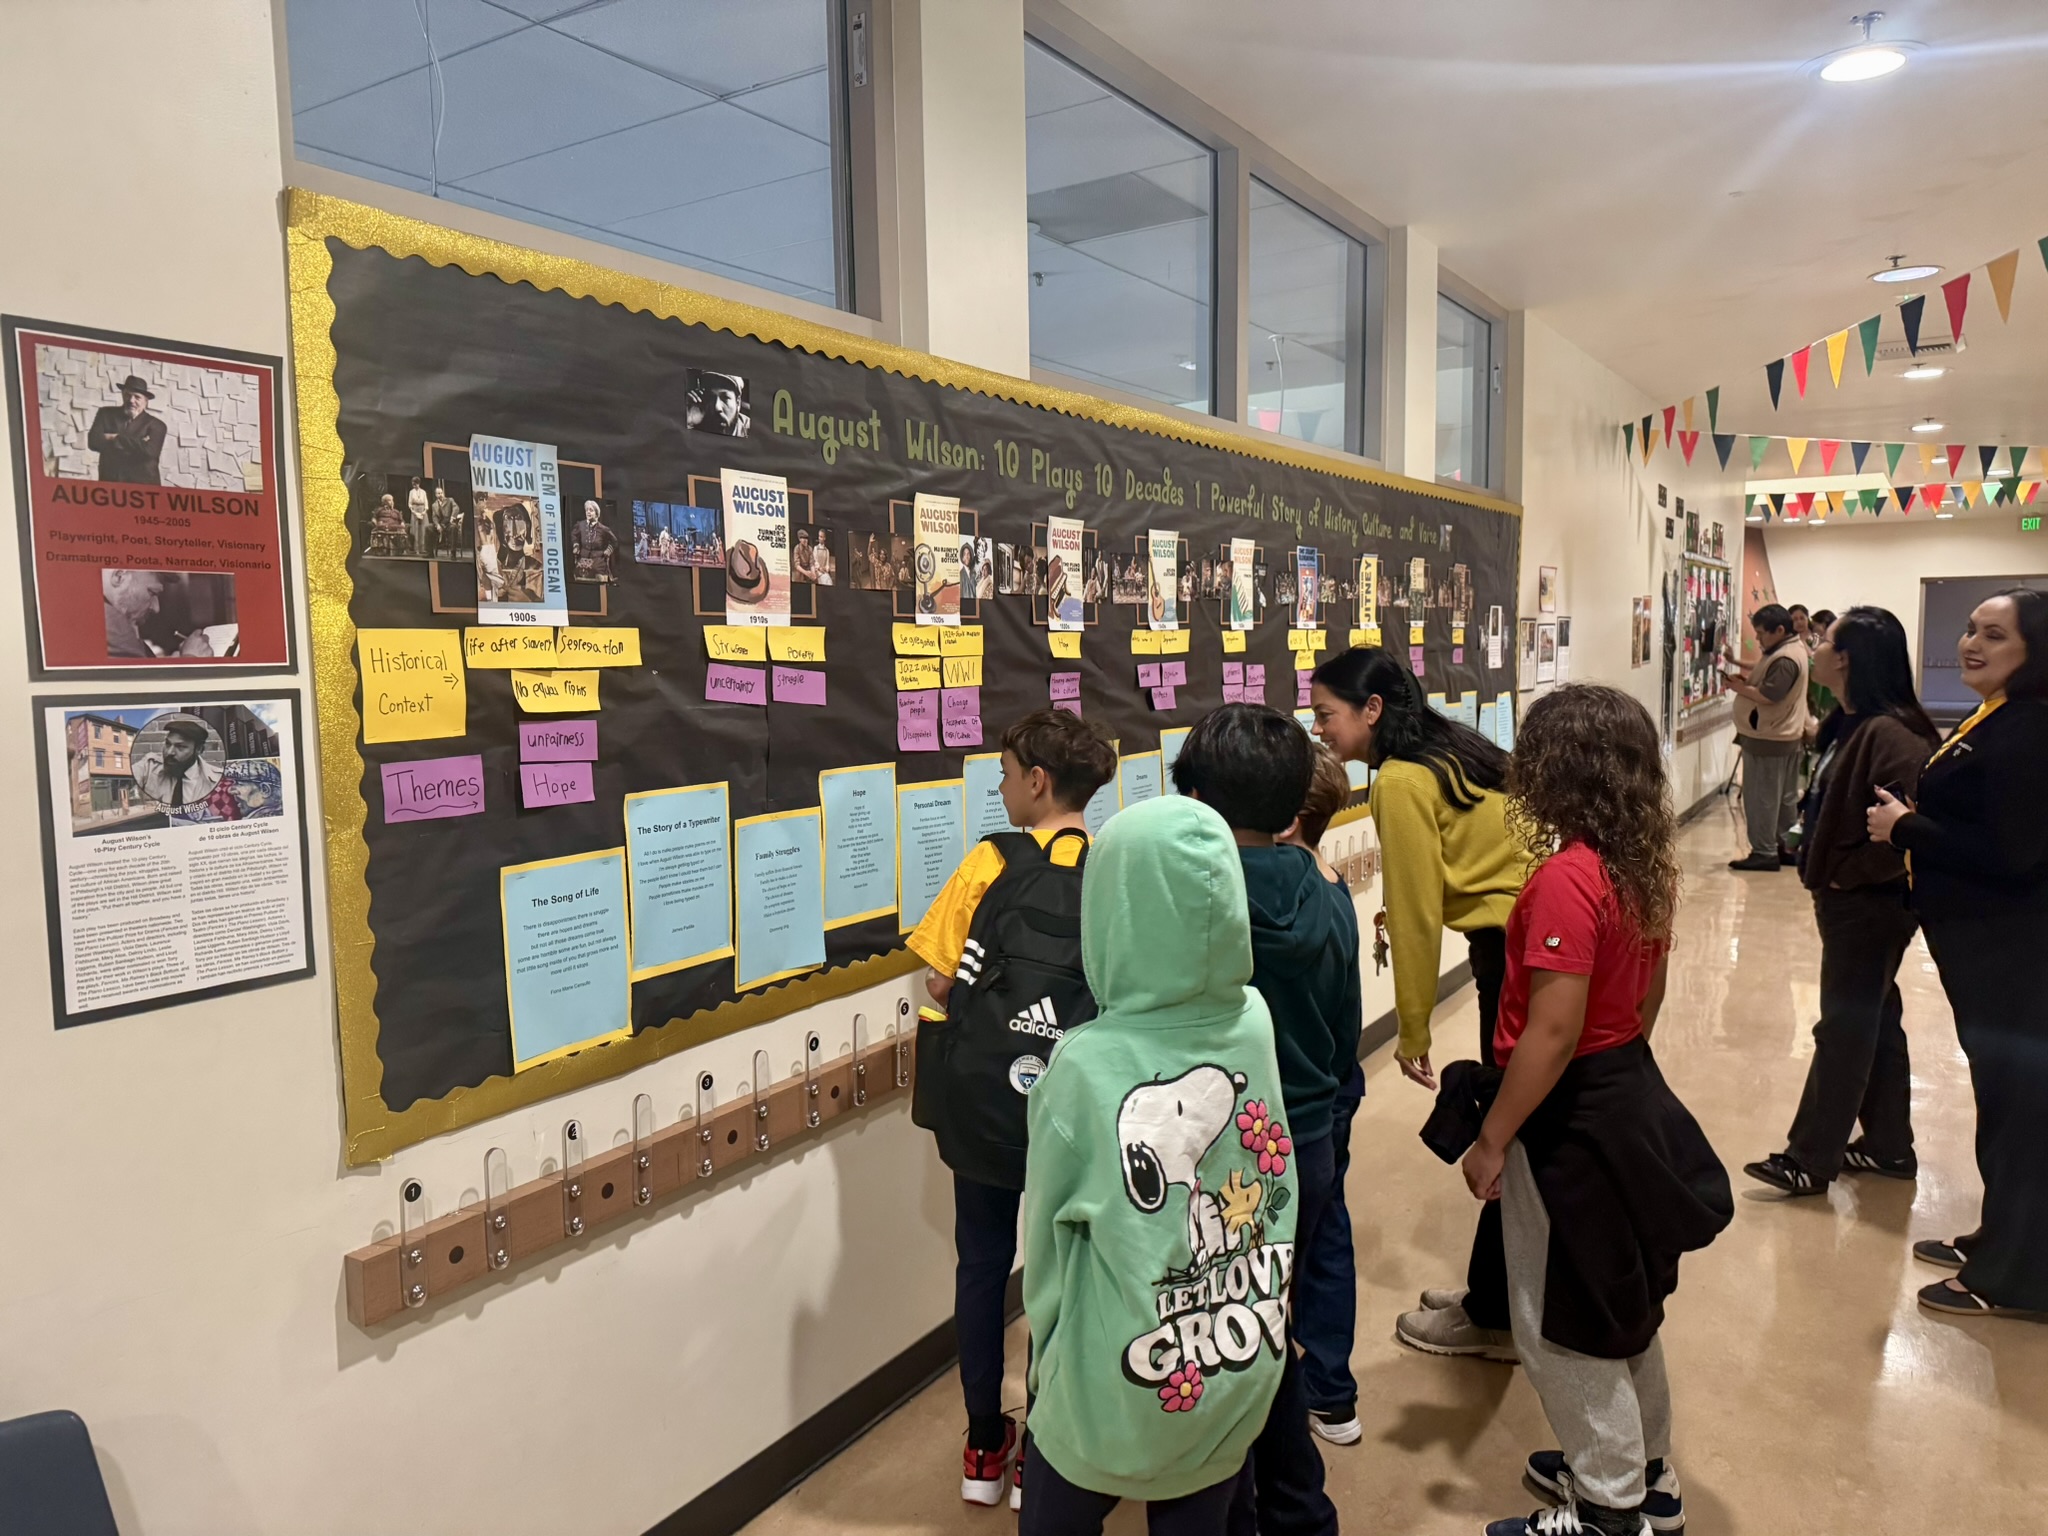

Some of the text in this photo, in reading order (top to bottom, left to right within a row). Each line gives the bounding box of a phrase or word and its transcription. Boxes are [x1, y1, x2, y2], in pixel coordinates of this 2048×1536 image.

[472, 442, 534, 468] AUGUST
[772, 388, 881, 466] August
[905, 418, 986, 471] Wilson:
[993, 439, 1020, 478] 10
[1032, 448, 1084, 510] Plays
[1094, 462, 1114, 498] 10
[1126, 466, 1184, 507] Decades
[1211, 482, 1265, 521] Powerful
[1272, 495, 1303, 540] Story
[1308, 497, 1320, 526] of
[1324, 506, 1358, 548] History
[1362, 512, 1393, 540] Culture
[1400, 516, 1415, 542] and
[1418, 522, 1438, 545] Voice
[472, 466, 535, 492] WILSON
[52, 484, 259, 516] AUGUST WILSON
[732, 484, 784, 504] AUGUST
[734, 500, 786, 518] WILSON
[920, 508, 958, 522] AUGUST
[540, 462, 560, 594] GEM OF THE OCEAN
[921, 520, 958, 534] WILSON
[2022, 518, 2041, 530] EXIT
[50, 530, 266, 552] Playwright, Poet, Storyteller, Visionary
[1052, 527, 1080, 540] AUGUST
[1052, 538, 1080, 551] WILSON
[1152, 539, 1176, 549] AUGUST
[1153, 548, 1175, 558] WILSON
[46, 551, 271, 570] Dramaturgo, Poeta, Narrador, Visionario
[509, 612, 537, 623] 1900s
[750, 615, 768, 624] 1910s
[490, 638, 518, 654] after
[370, 648, 448, 674] Historical
[898, 660, 920, 674] Jazz
[920, 664, 931, 672] and
[515, 680, 529, 700] No
[378, 692, 434, 716] Context
[947, 696, 968, 710] Change
[386, 769, 480, 805] Themes
[532, 772, 577, 800] Hope
[853, 789, 866, 797] Hope
[155, 800, 209, 815] August Wilson
[637, 826, 652, 835] The
[653, 824, 673, 832] Story
[674, 821, 681, 829] of
[688, 816, 721, 828] Typewriter
[102, 838, 124, 846] August
[755, 846, 800, 860] Family Struggles
[531, 887, 600, 908] The Song of Life
[903, 1004, 908, 1013] 5
[1009, 1016, 1064, 1040] adidas
[705, 1078, 710, 1086] 3
[1208, 1242, 1294, 1304] LOVE
[1157, 1280, 1209, 1320] LET
